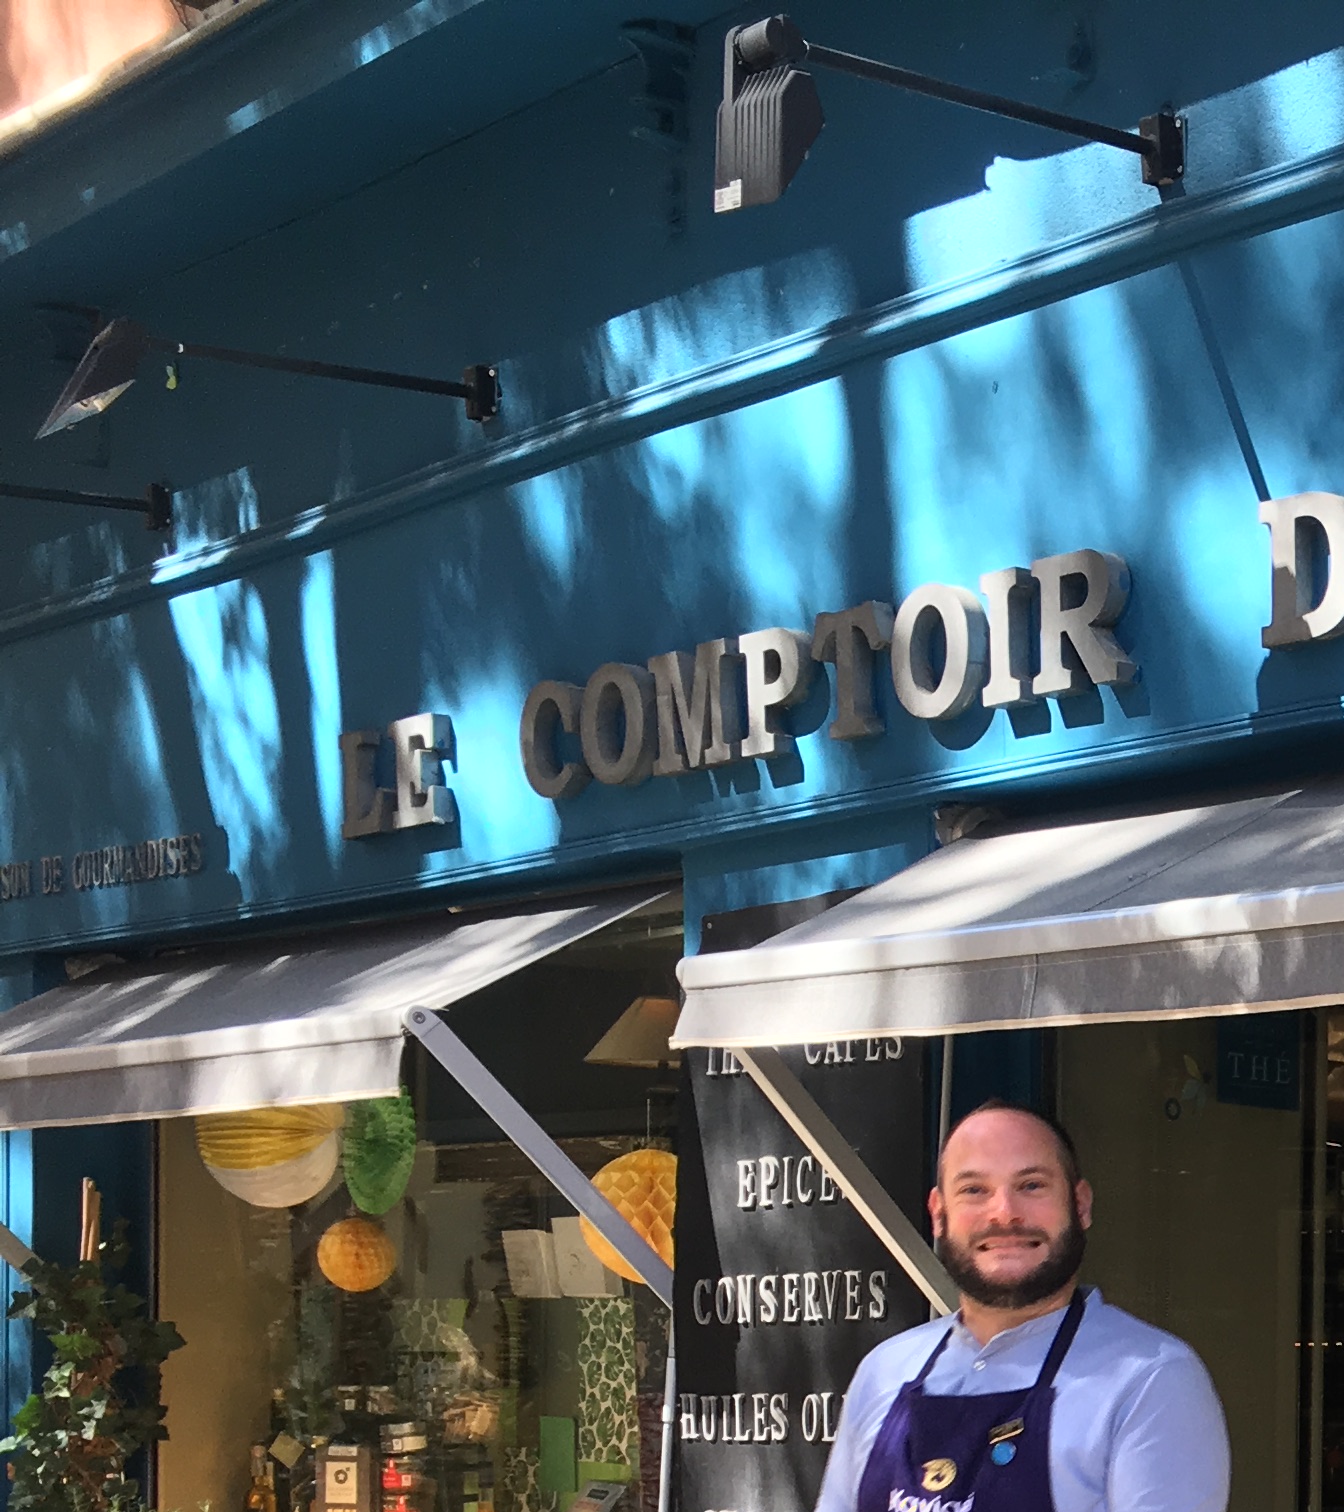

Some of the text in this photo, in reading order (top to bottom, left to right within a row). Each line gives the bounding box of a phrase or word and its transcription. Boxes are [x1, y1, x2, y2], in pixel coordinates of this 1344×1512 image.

[339, 712, 459, 840] LE
[518, 547, 1139, 799] COMPTOIR
[41, 855, 63, 895] DE
[72, 833, 201, 890] GOURMANDISES
[1227, 1051, 1292, 1085] THÉ
[736, 1154, 848, 1209] EPICE
[693, 1269, 888, 1327] CONSERVES
[680, 1392, 789, 1442] HUILES
